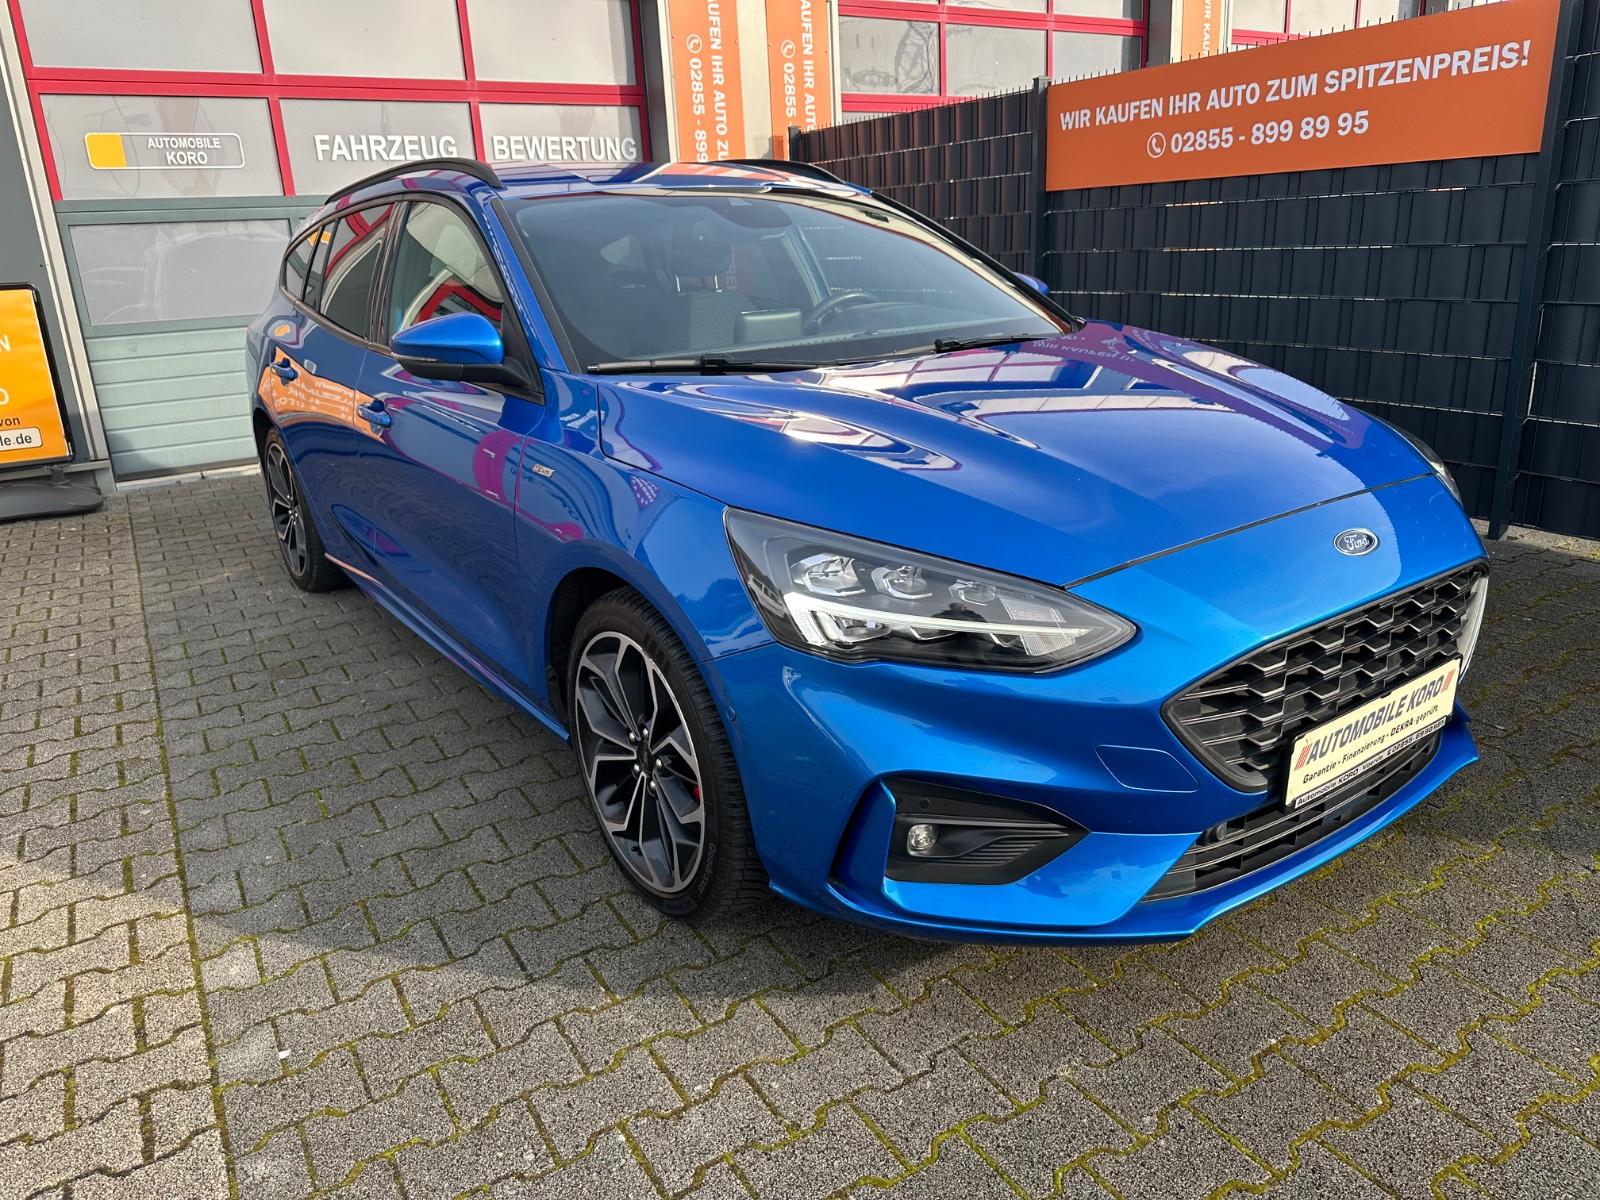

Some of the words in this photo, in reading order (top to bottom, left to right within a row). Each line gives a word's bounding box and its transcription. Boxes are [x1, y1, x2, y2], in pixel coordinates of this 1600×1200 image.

[711, 55, 725, 86] IHR
[803, 60, 815, 89] IHR
[1060, 109, 1091, 131] WIR
[1095, 97, 1164, 126] KAUFEN
[1168, 91, 1202, 116] IHR
[1206, 82, 1261, 111] AUTO
[1265, 73, 1318, 102] ZUM
[1324, 39, 1532, 94] SPITZENPREIS!
[689, 58, 706, 116] 02855
[783, 63, 797, 118] 02855
[713, 90, 728, 136] AUTO
[147, 137, 222, 149] AUTOMOBILE
[314, 134, 458, 161] FAHRZEUG
[492, 135, 637, 161] BEWERTUNG
[694, 130, 709, 162] 899
[1170, 126, 1234, 154] 02855
[1251, 119, 1294, 145] 899
[1299, 115, 1331, 140] 89
[1337, 110, 1370, 136] 95
[166, 151, 208, 165] KORO
[1306, 694, 1408, 766] AUTOMOBILE
[1406, 675, 1445, 713] KORO
[1303, 761, 1337, 784] Garantie
[1338, 768, 1359, 785] KORO
